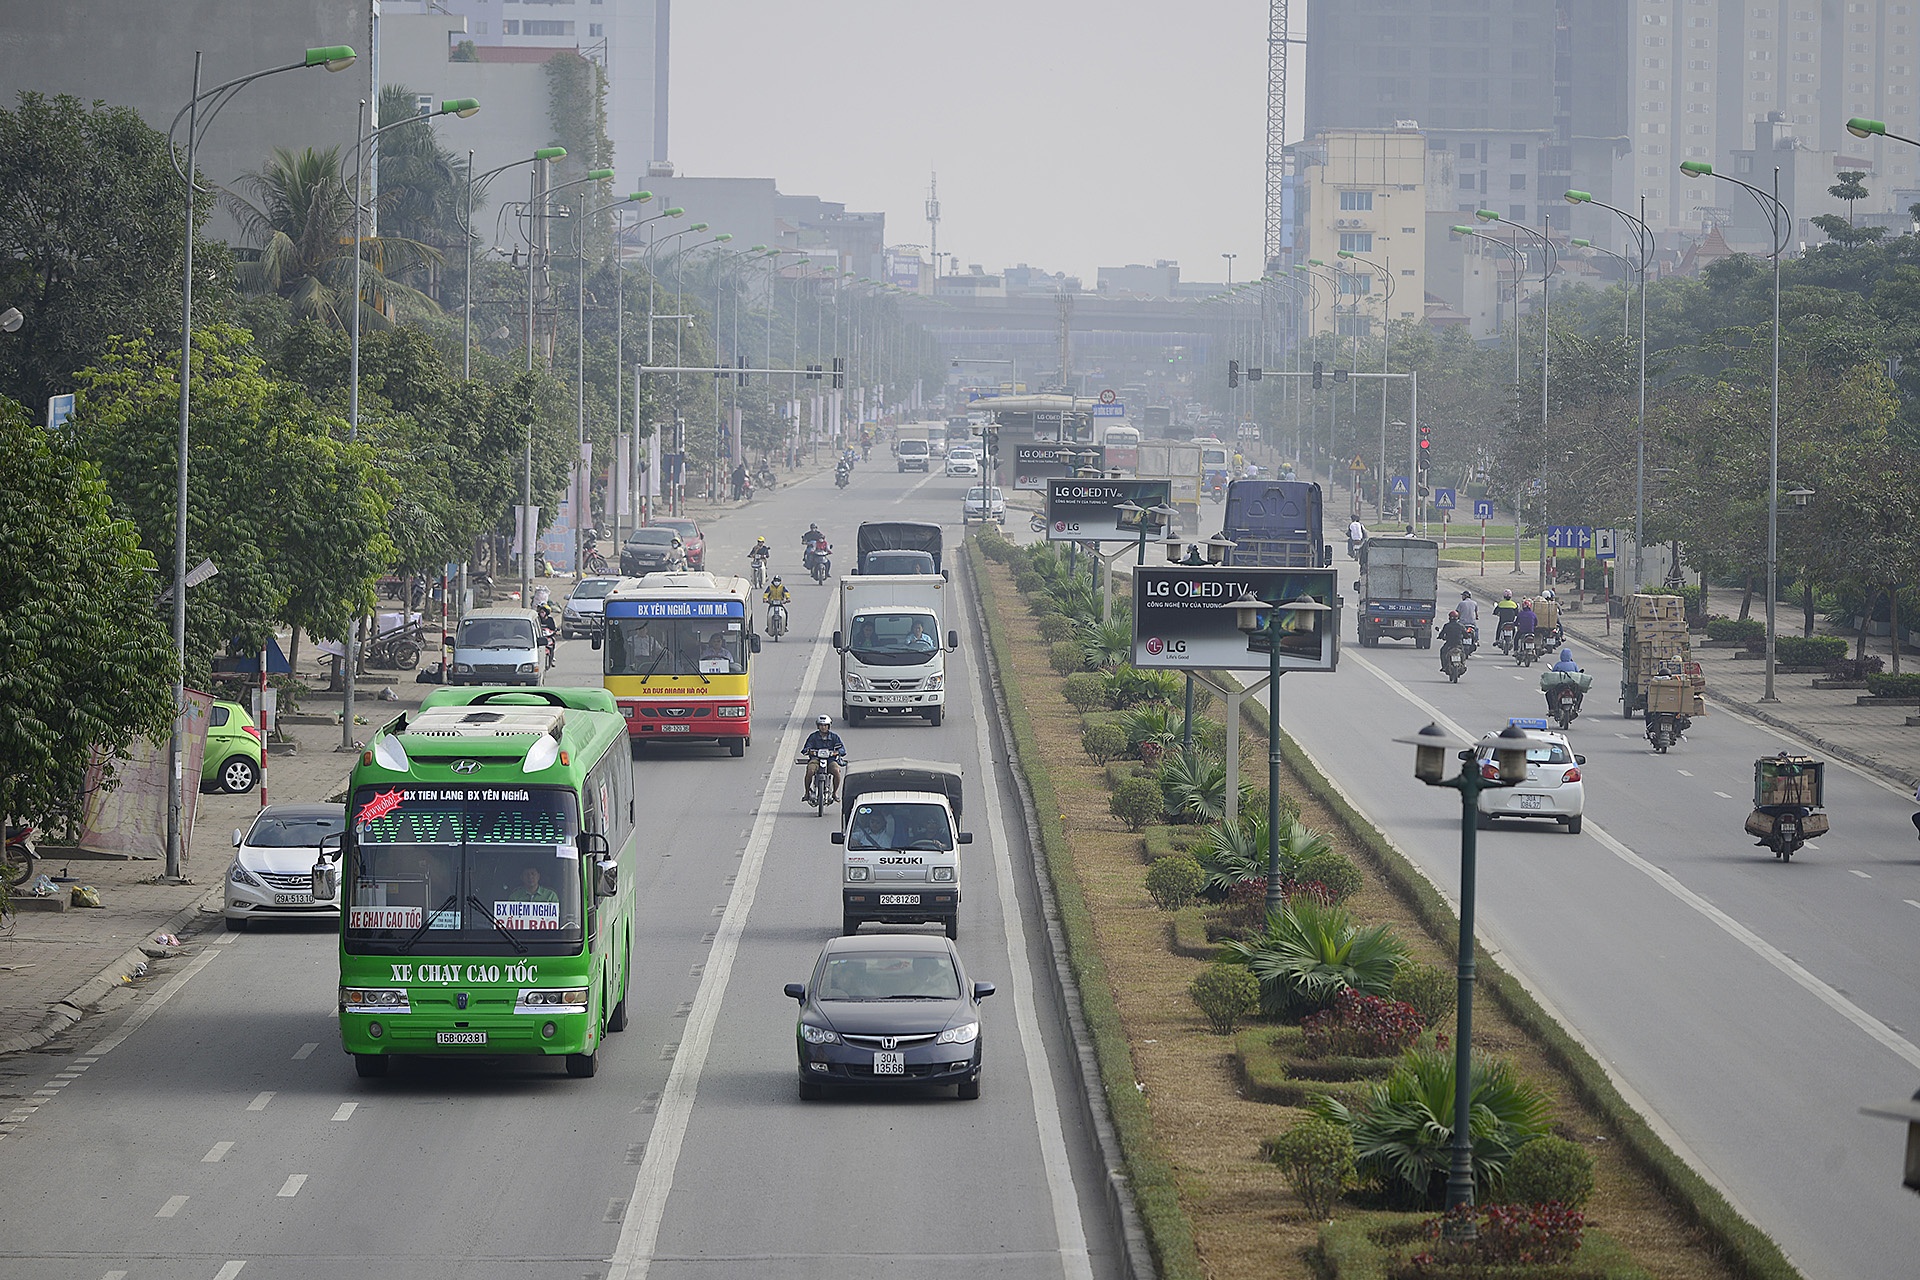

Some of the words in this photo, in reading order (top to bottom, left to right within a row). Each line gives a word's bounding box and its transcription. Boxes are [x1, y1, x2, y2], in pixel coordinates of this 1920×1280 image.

[1020, 450, 1030, 458] LG
[1055, 487, 1069, 496] LG
[1072, 487, 1102, 497] OLED
[1067, 523, 1079, 531] LG
[1147, 581, 1169, 596] LG
[1174, 581, 1223, 597] OLED
[638, 604, 649, 615] BX
[650, 603, 665, 615] YÊN
[667, 603, 691, 615] NGHĨA
[698, 604, 713, 615] KIM
[1167, 640, 1186, 653] LG
[404, 791, 416, 800] BX
[418, 791, 437, 800] TIEN
[440, 791, 463, 800] LANG
[468, 791, 479, 800] BX
[482, 789, 499, 800] YÊN
[501, 789, 529, 801] NGHĨA
[879, 857, 923, 865] SUZUKI
[881, 896, 919, 904] 29C-812.80
[496, 904, 507, 916] BX
[510, 902, 530, 918] NIỆM
[533, 903, 557, 916] NGHĨA
[351, 911, 361, 927] XE
[386, 912, 402, 928] CAO
[405, 908, 421, 928] TỐC
[390, 964, 413, 982] XE
[418, 964, 462, 985] CHẠY
[466, 964, 500, 983] CAO
[504, 958, 539, 983] TỐC
[438, 1034, 485, 1043] 15B-023.81
[881, 1053, 897, 1063] 30A
[875, 1064, 903, 1073] 135.66
